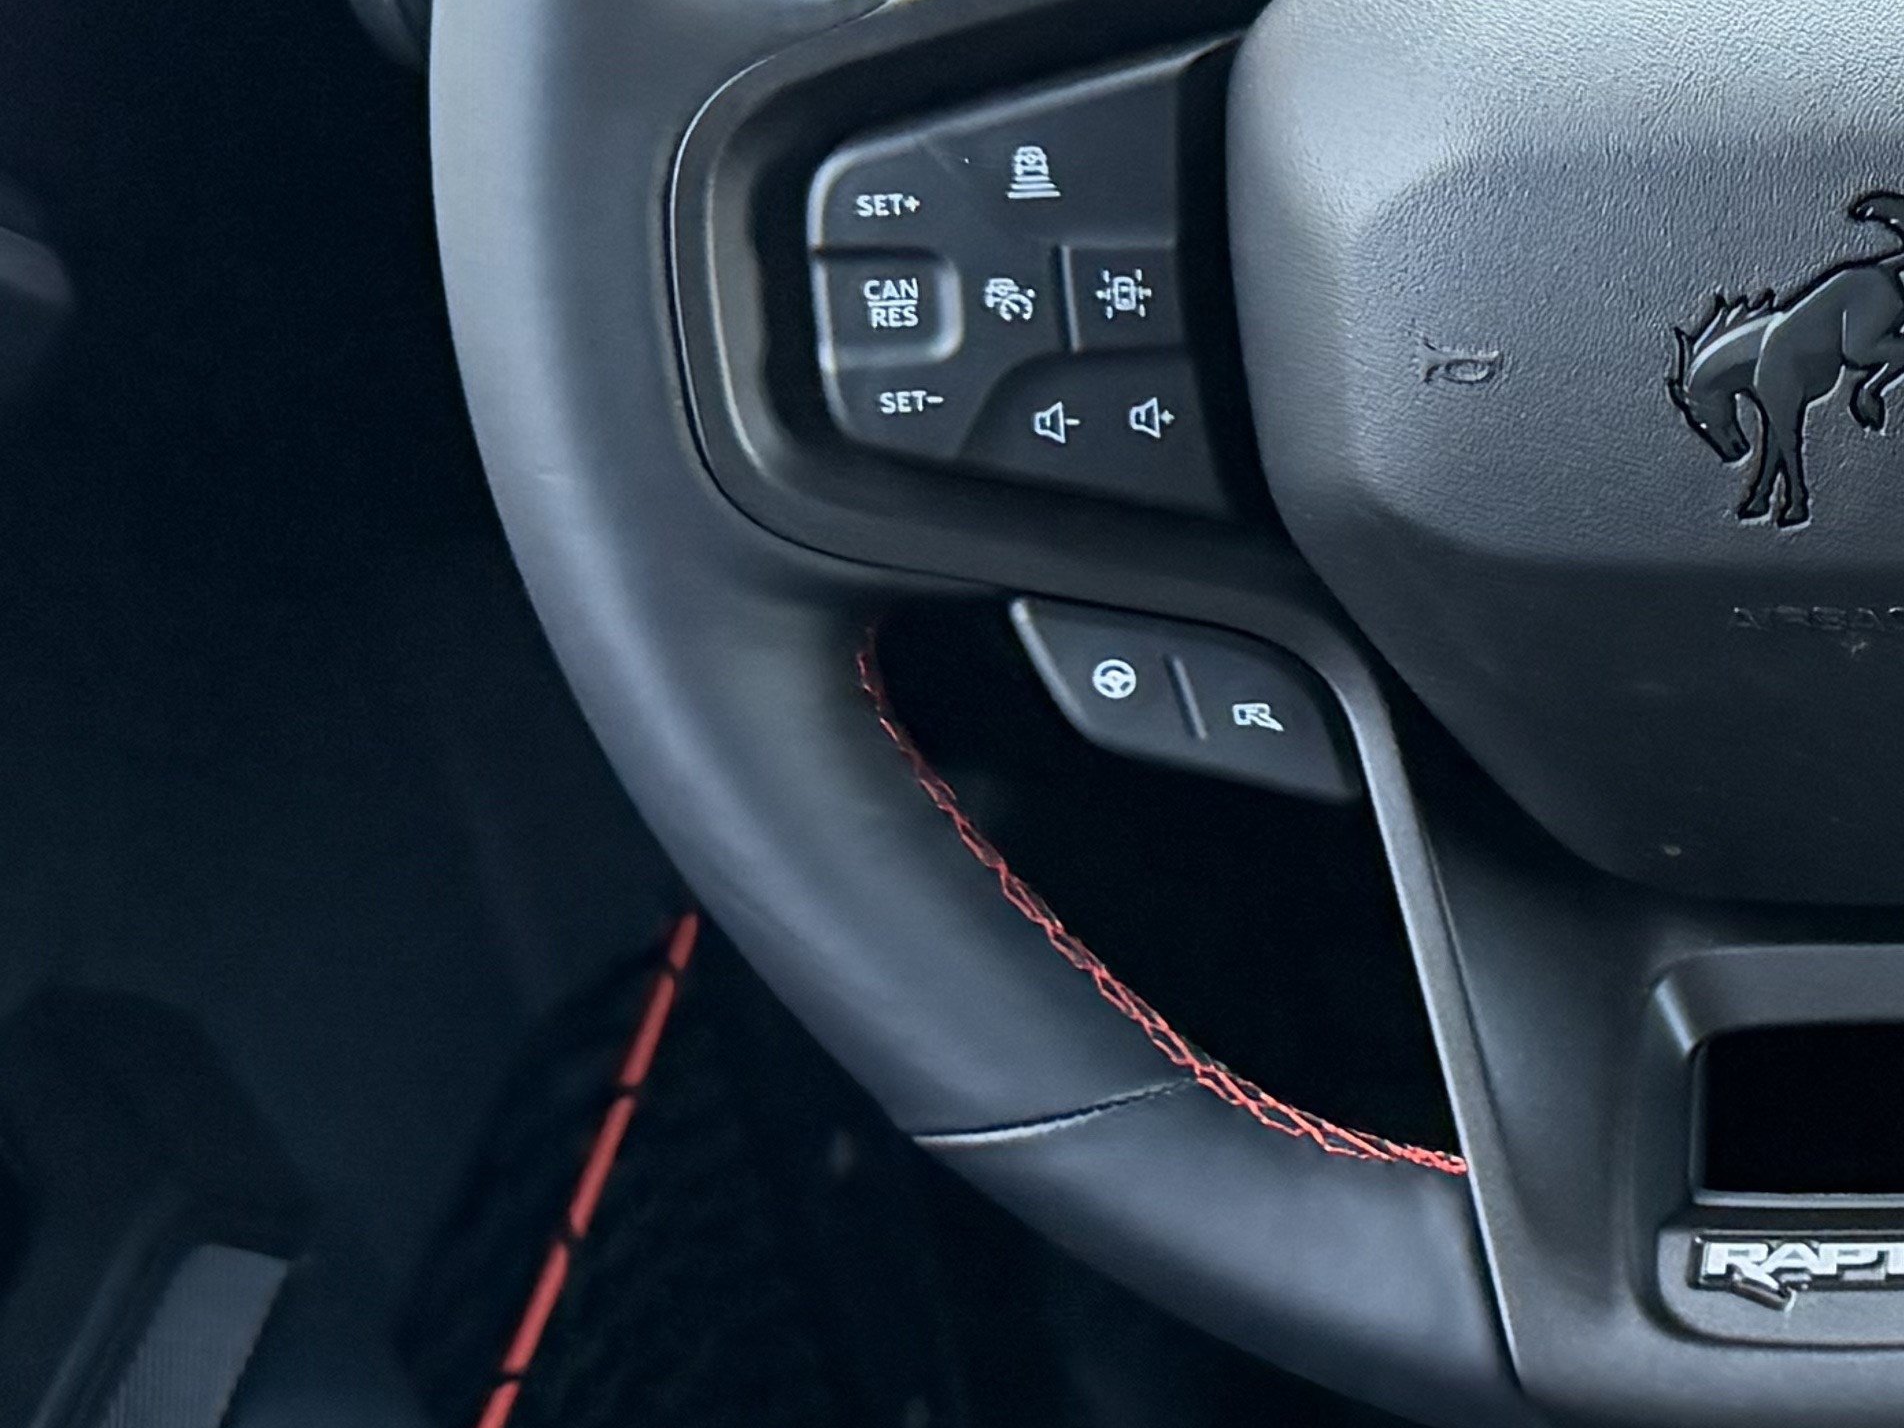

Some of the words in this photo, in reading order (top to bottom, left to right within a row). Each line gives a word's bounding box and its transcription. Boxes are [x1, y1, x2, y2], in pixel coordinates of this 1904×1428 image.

[856, 193, 921, 219] SET+
[863, 278, 919, 301] CAN
[870, 306, 919, 329] RES
